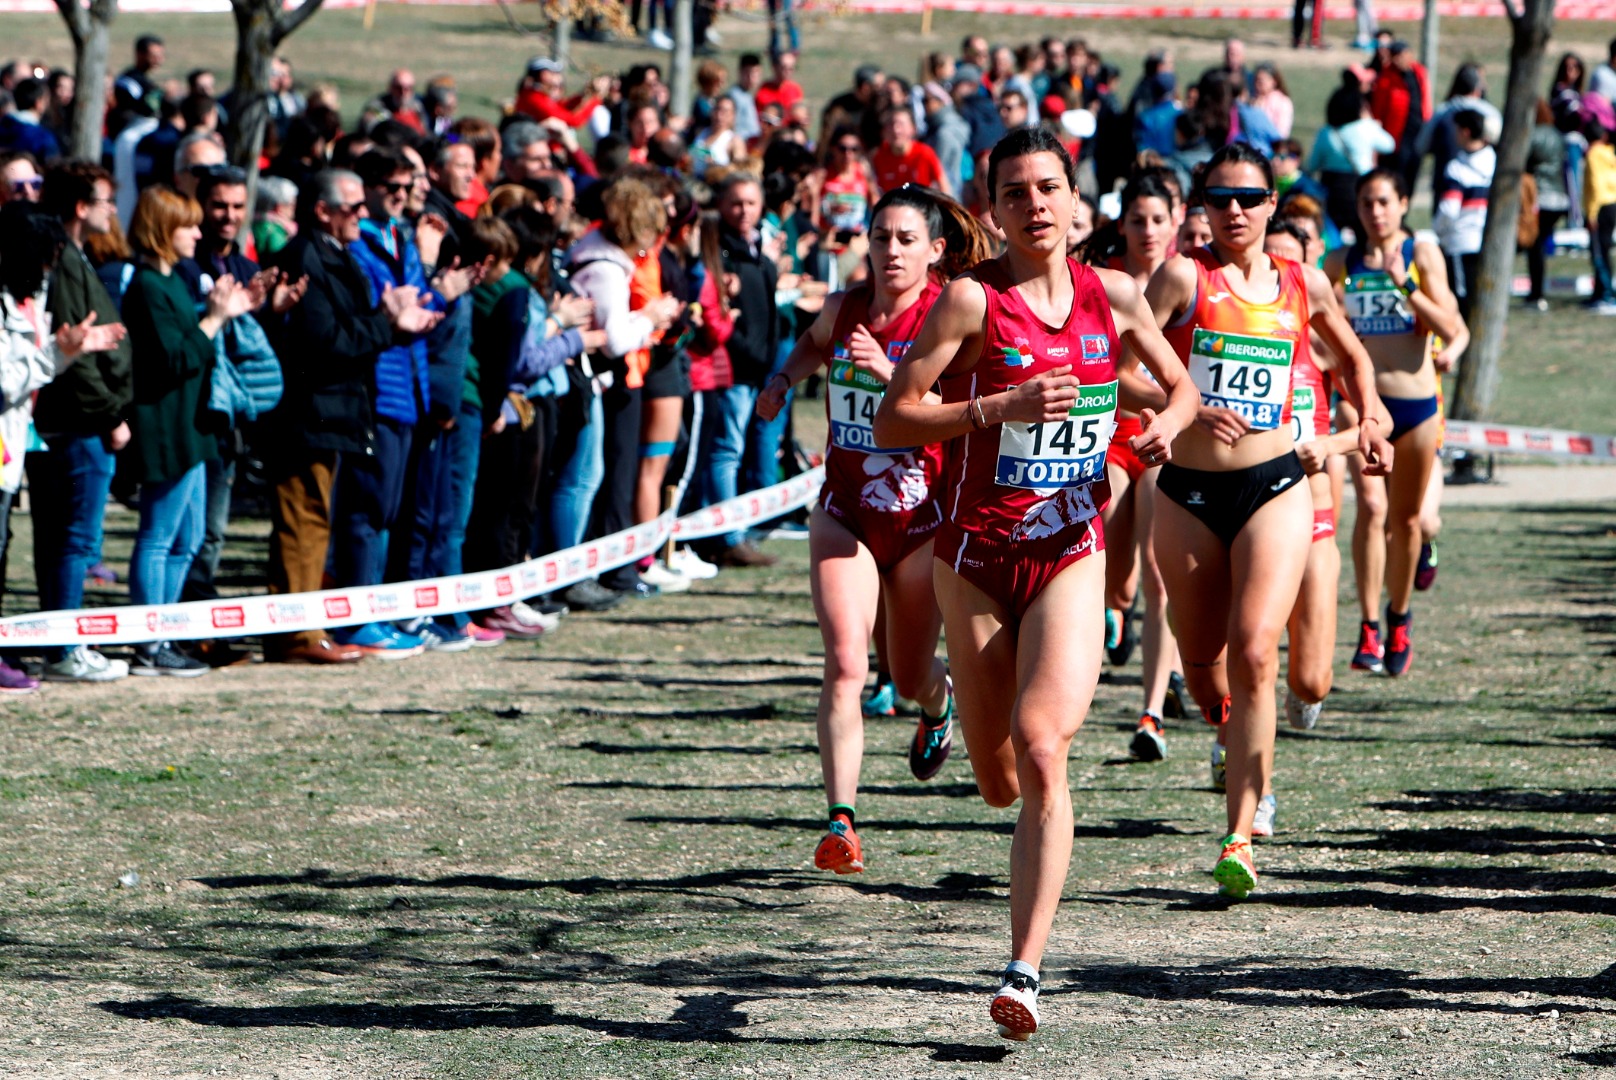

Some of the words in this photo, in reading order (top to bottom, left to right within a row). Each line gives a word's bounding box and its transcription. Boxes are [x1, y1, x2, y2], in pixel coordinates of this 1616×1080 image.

[1355, 292, 1399, 316] 152
[1224, 342, 1288, 360] IBERDROLA
[1208, 362, 1272, 398] 149
[843, 391, 875, 426] 14
[1075, 393, 1114, 409] DROLA
[1026, 418, 1100, 456] 145
